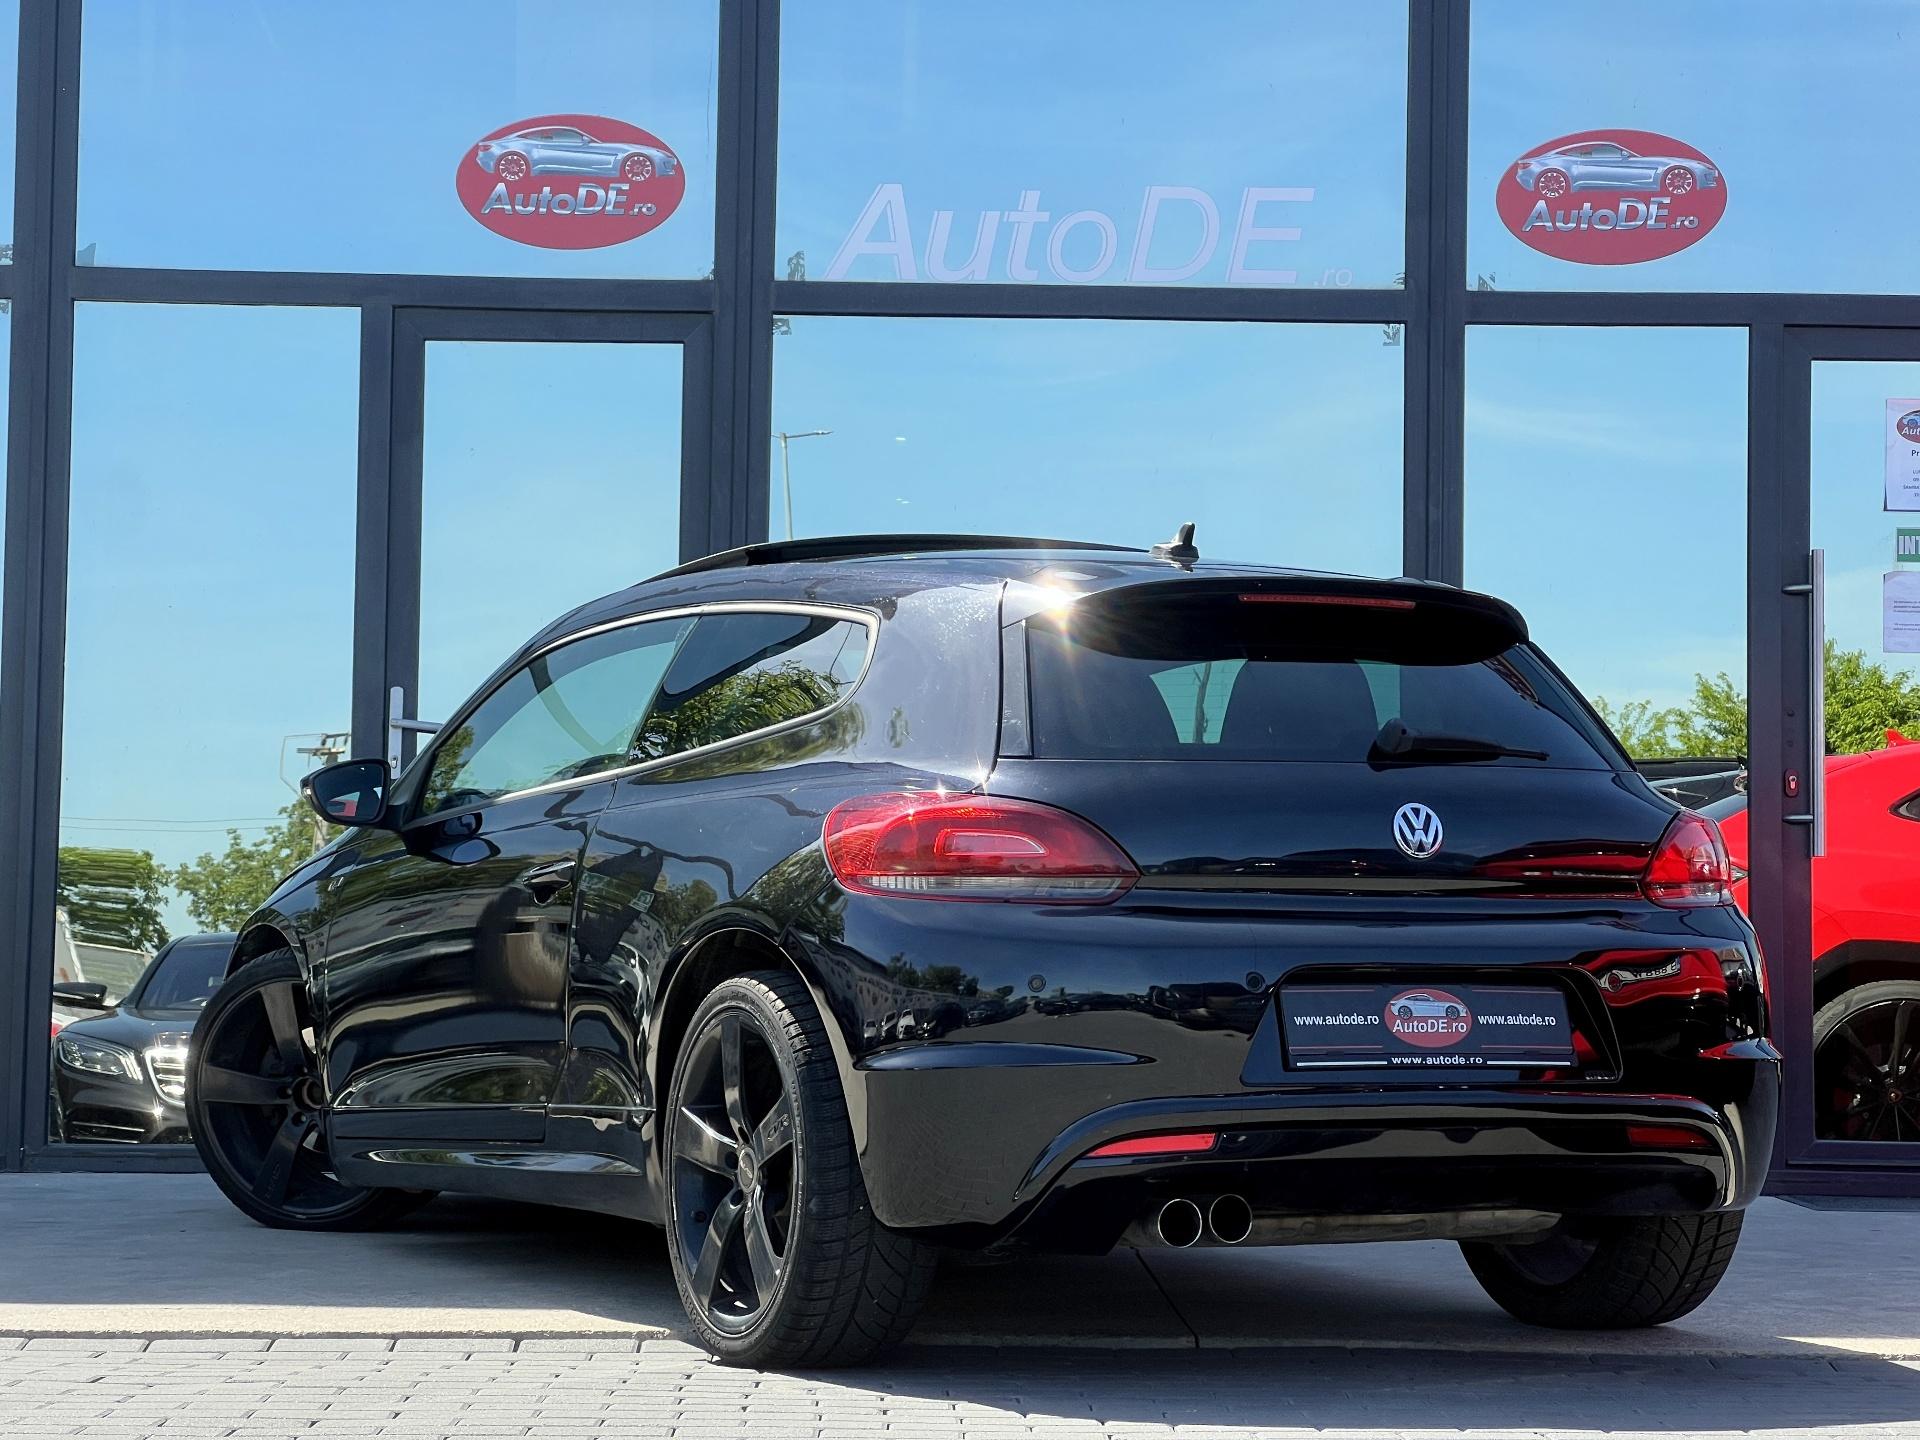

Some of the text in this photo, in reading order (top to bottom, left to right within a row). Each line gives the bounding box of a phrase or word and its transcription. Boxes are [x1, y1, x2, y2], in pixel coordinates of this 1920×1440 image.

[481, 182, 657, 217] AutoDE.ro
[1521, 196, 1699, 232] AutoDE.ro
[1294, 1013, 1557, 1033] www.autode.ro AutoDE.ro www.autode.ro
[1391, 1055, 1483, 1065] www.autode.ro
